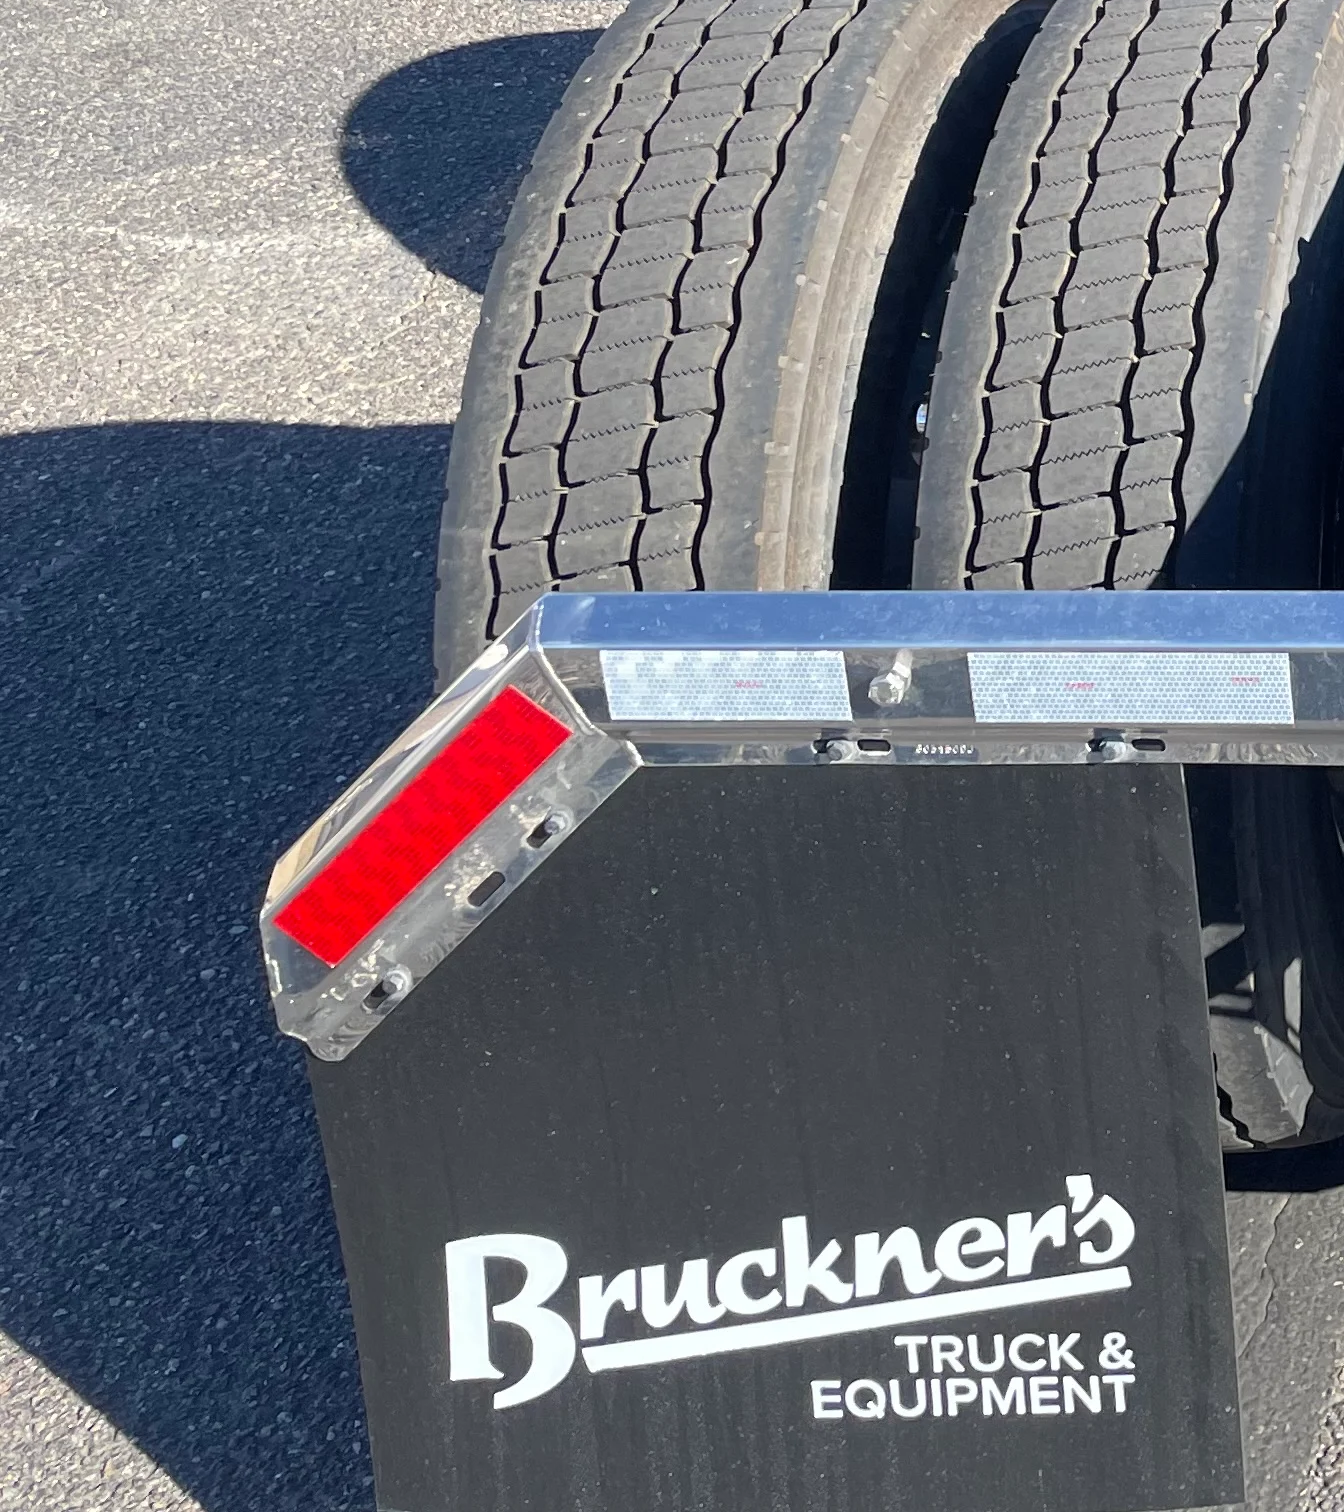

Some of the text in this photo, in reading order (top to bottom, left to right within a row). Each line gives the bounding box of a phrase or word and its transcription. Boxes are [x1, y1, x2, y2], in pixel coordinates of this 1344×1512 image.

[445, 1174, 1136, 1410] Bruckner's
[893, 1332, 1136, 1374] TRUCK &
[810, 1374, 1136, 1419] EQUIPMENT
